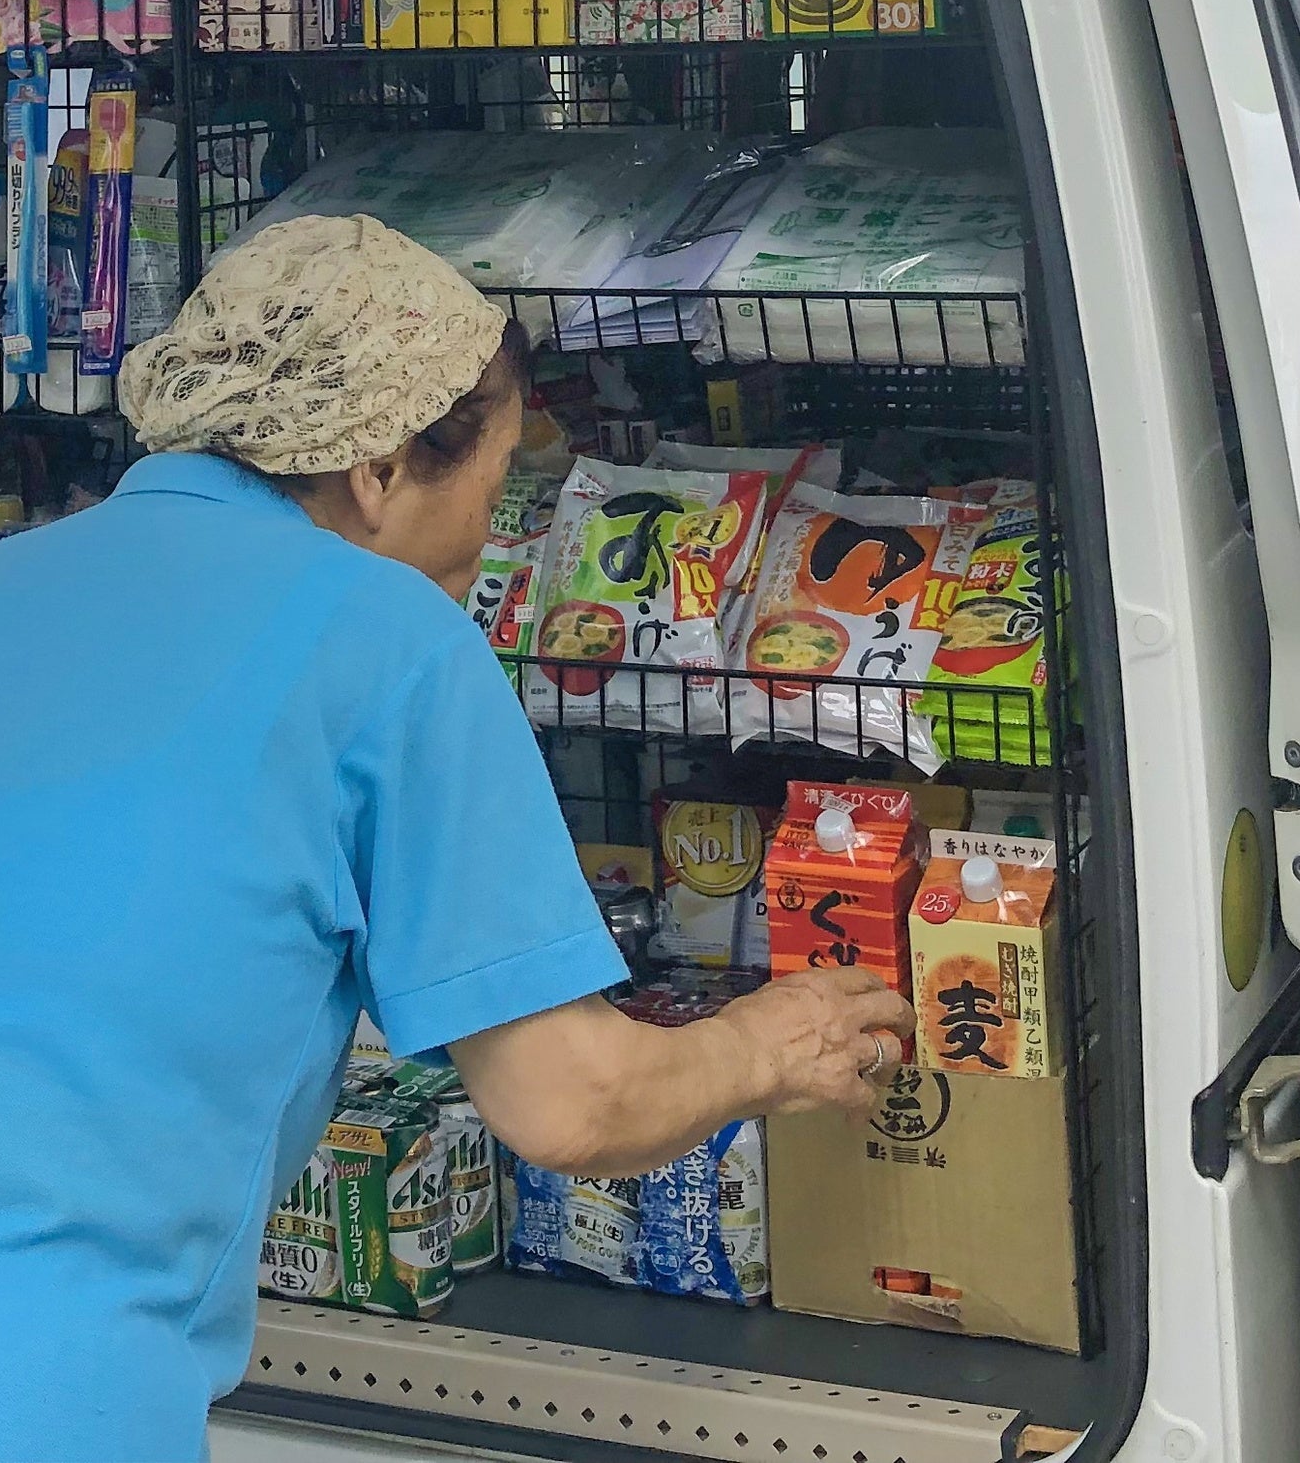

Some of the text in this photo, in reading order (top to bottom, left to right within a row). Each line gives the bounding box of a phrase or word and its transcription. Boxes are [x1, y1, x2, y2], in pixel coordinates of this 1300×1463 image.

[943, 523, 975, 572] 白みそ
[679, 559, 717, 597] 10
[674, 806, 747, 869] No.1
[943, 837, 1045, 863] 香りはなやか
[1000, 946, 1019, 1014] むぎ焼酎
[936, 979, 1010, 1071] 麦
[330, 1155, 372, 1180] New!
